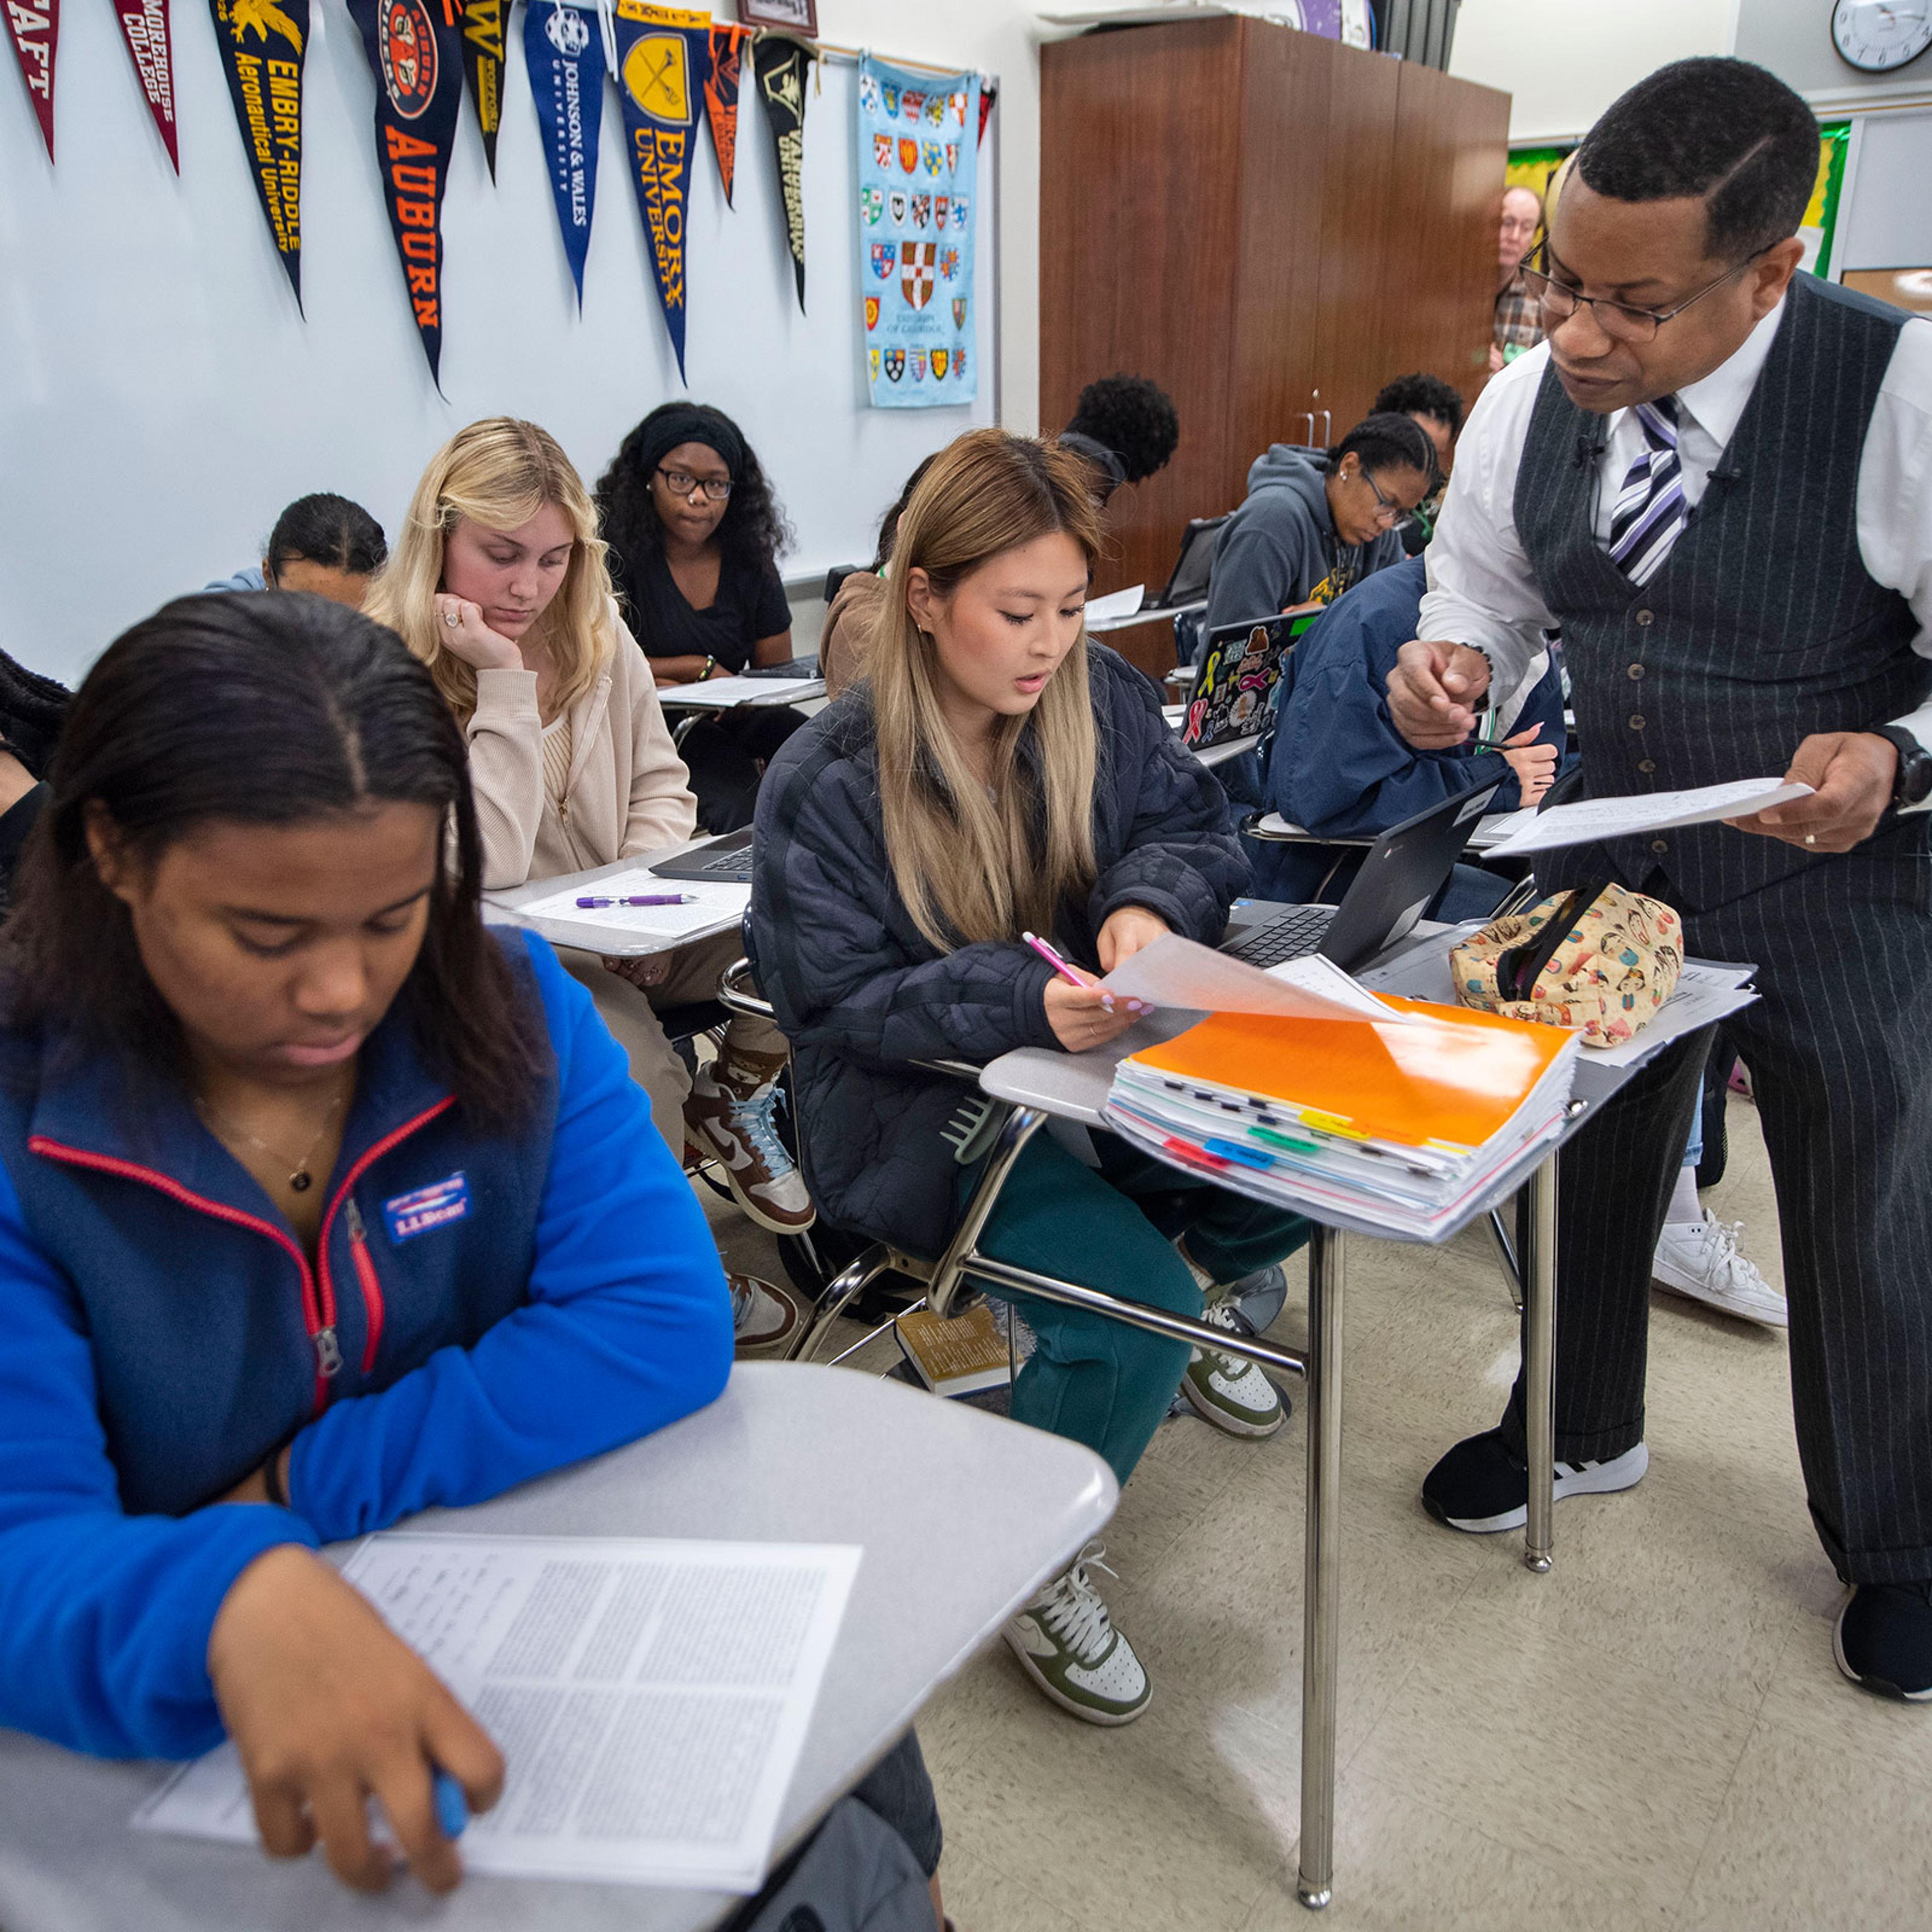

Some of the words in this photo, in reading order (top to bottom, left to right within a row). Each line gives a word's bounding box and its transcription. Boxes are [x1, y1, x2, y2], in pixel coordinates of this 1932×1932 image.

[7, 0, 50, 100] AFT
[123, 13, 160, 104] COLLEGE
[142, 0, 173, 122] MOREHOUSE
[411, 10, 431, 97] AUBURN
[464, 0, 503, 61] W
[234, 51, 276, 163] Aeronautical
[261, 168, 289, 253] University
[267, 58, 300, 251] EMBRY-RIDDLE
[552, 59, 568, 192] UNIVERSITY
[561, 58, 583, 149] JOHNSON
[570, 150, 584, 168] &
[384, 125, 438, 329] AUBURN
[572, 169, 587, 227] WALES
[634, 127, 675, 309] UNIVERSITY
[655, 128, 686, 309] EMORY
